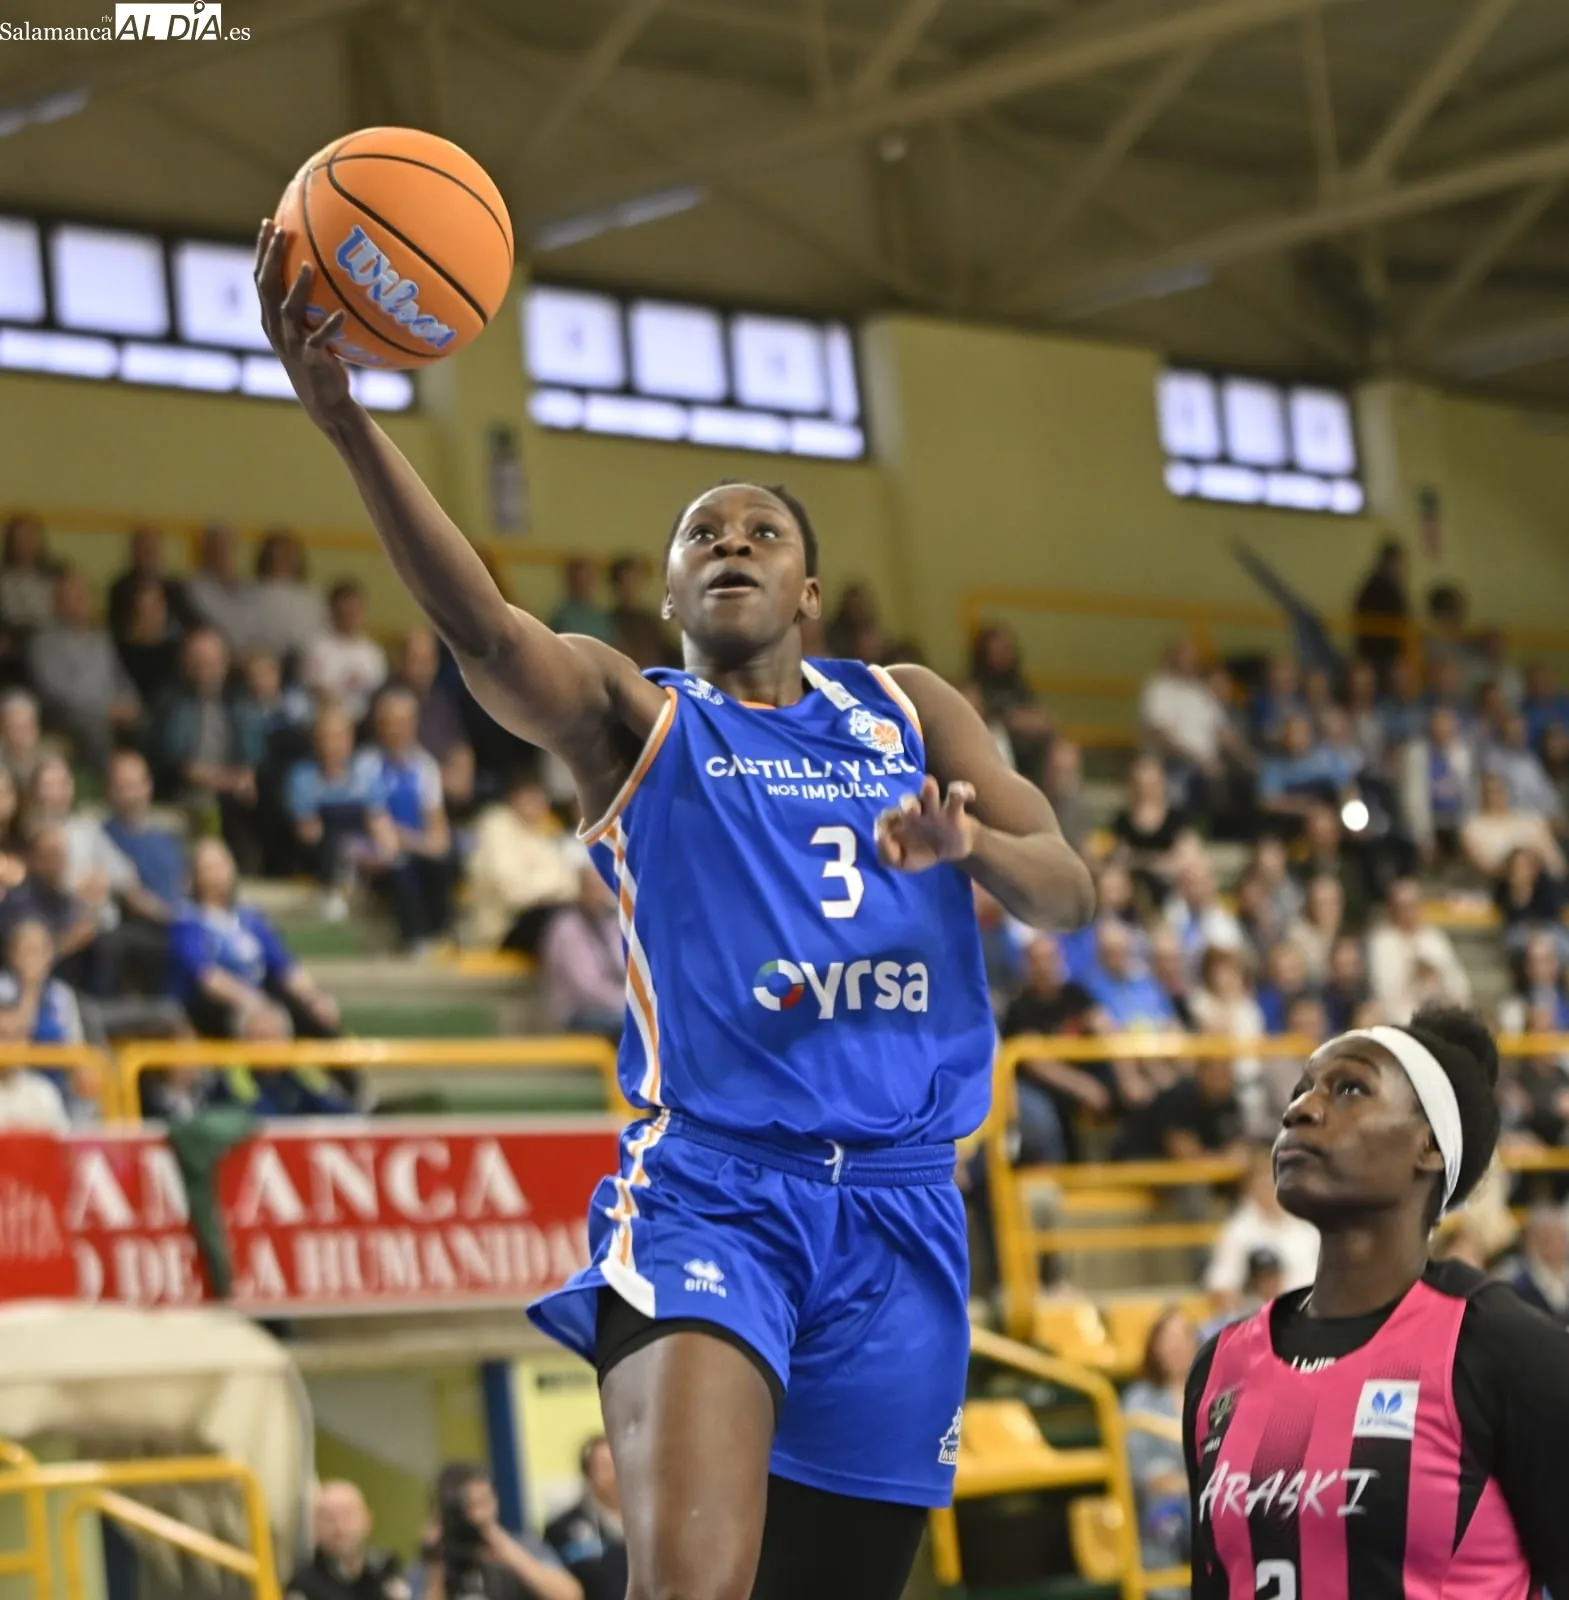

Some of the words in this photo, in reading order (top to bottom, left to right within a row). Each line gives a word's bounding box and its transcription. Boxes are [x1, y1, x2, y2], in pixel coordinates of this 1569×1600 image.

[335, 224, 457, 349] Wilson
[767, 783, 799, 797] NOS
[802, 782, 889, 802] IMPULSA
[842, 759, 862, 783] Y
[809, 826, 865, 919] 3
[1200, 1459, 1381, 1524] ARASKI
